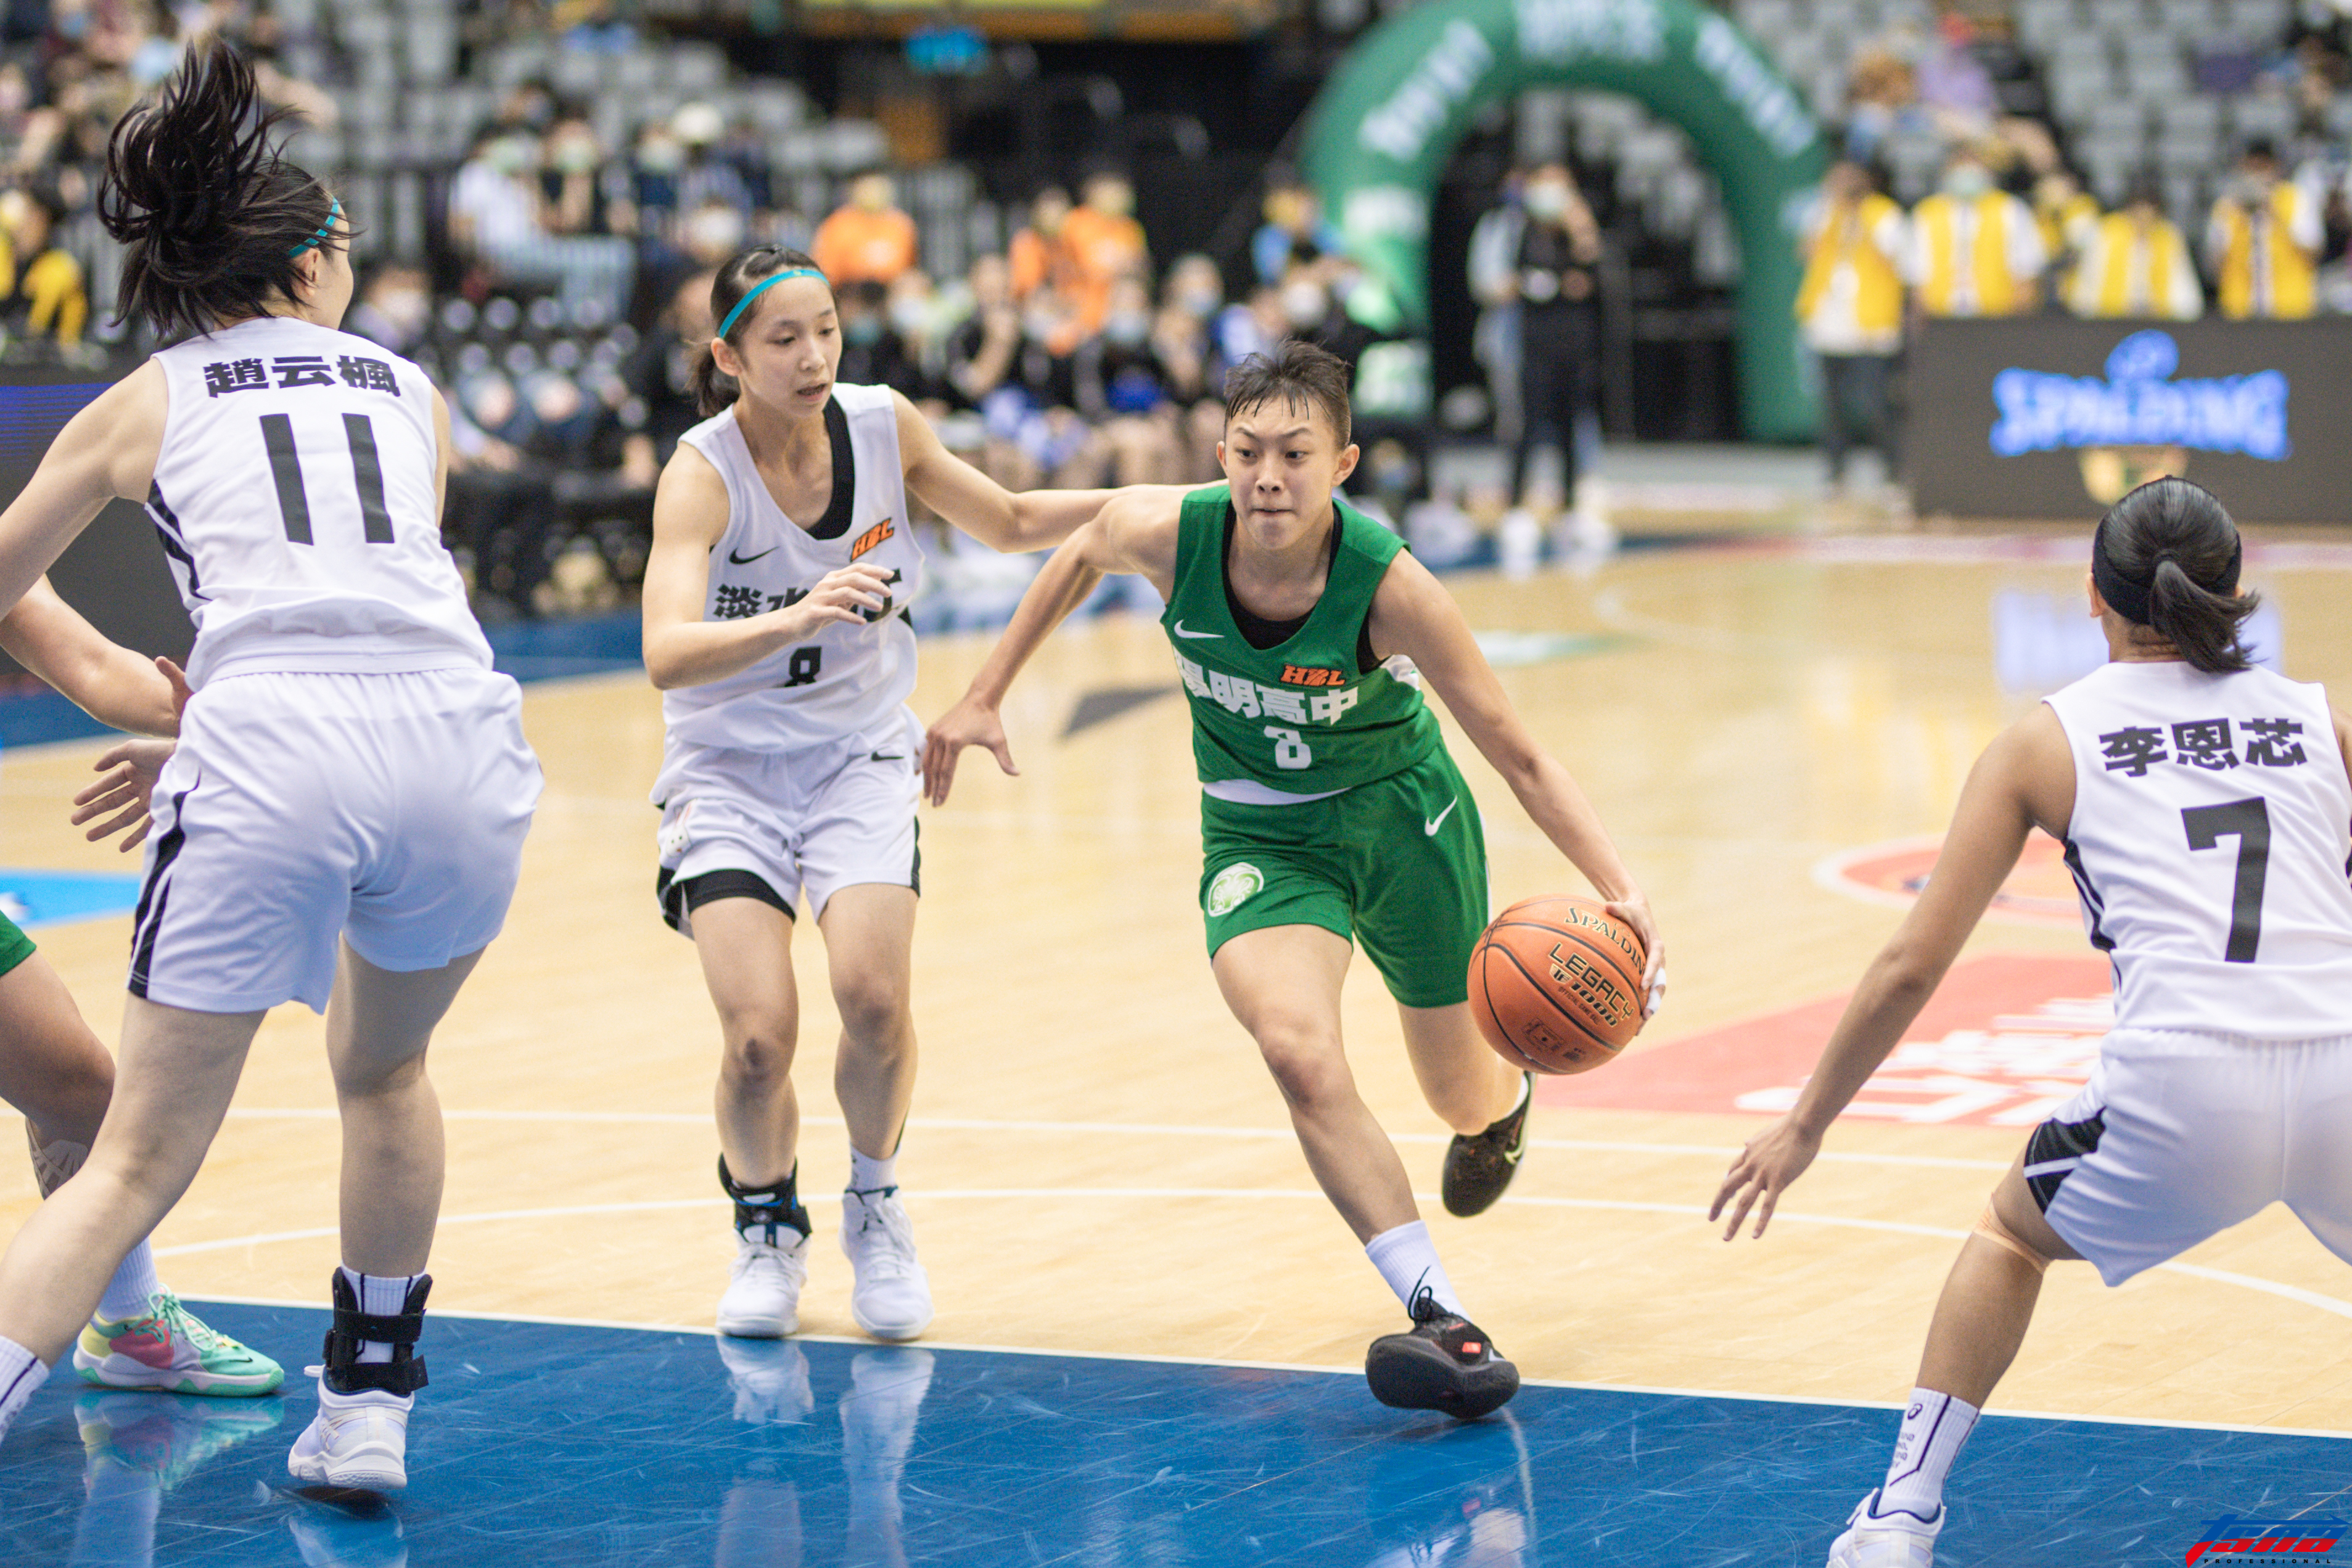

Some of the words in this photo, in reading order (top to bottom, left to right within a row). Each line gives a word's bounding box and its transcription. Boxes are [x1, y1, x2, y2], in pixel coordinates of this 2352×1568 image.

[203, 355, 401, 398] 趙云楓
[259, 413, 395, 546] 11
[850, 517, 895, 562] HBL
[713, 568, 902, 623] 淡水
[1280, 663, 1347, 688] HBL
[2099, 717, 2308, 778] 李恩芯
[2180, 797, 2271, 963] 7
[1565, 906, 1646, 976] SPALDIN
[1548, 942, 1634, 1020] LEGACY
[1570, 981, 1618, 1028] 1000
